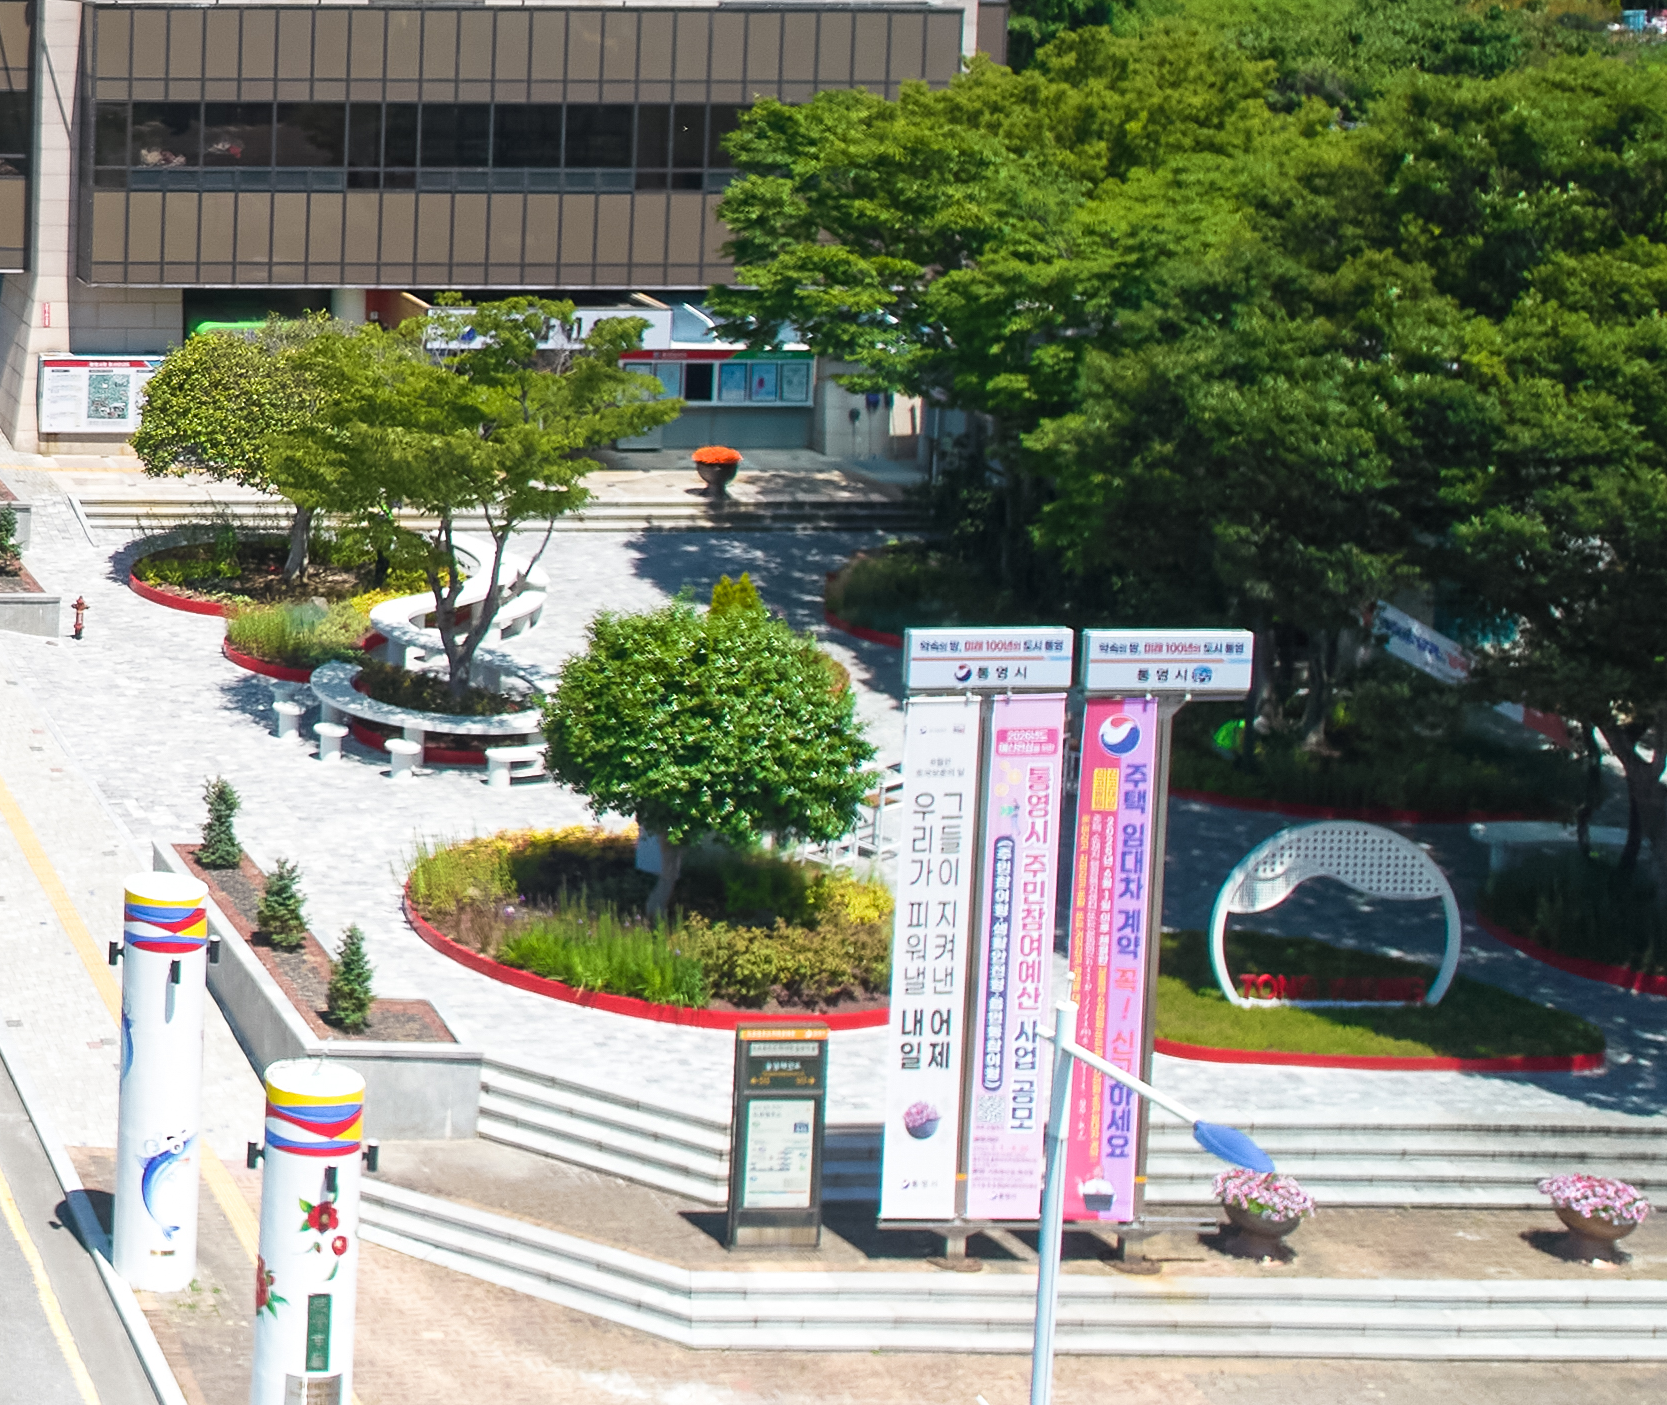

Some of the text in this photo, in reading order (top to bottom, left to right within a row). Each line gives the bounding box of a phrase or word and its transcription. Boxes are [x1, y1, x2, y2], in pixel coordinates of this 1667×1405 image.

[1118, 823, 1145, 900] 임대차
[1124, 764, 1147, 814] 주택
[900, 792, 936, 1071] 우리가 피워낼 내일
[928, 792, 964, 1070] 그들이 지켜낸 어제
[1010, 767, 1050, 1129] 통영시 주민참여예산 사업 공모
[1117, 909, 1141, 960] 계약
